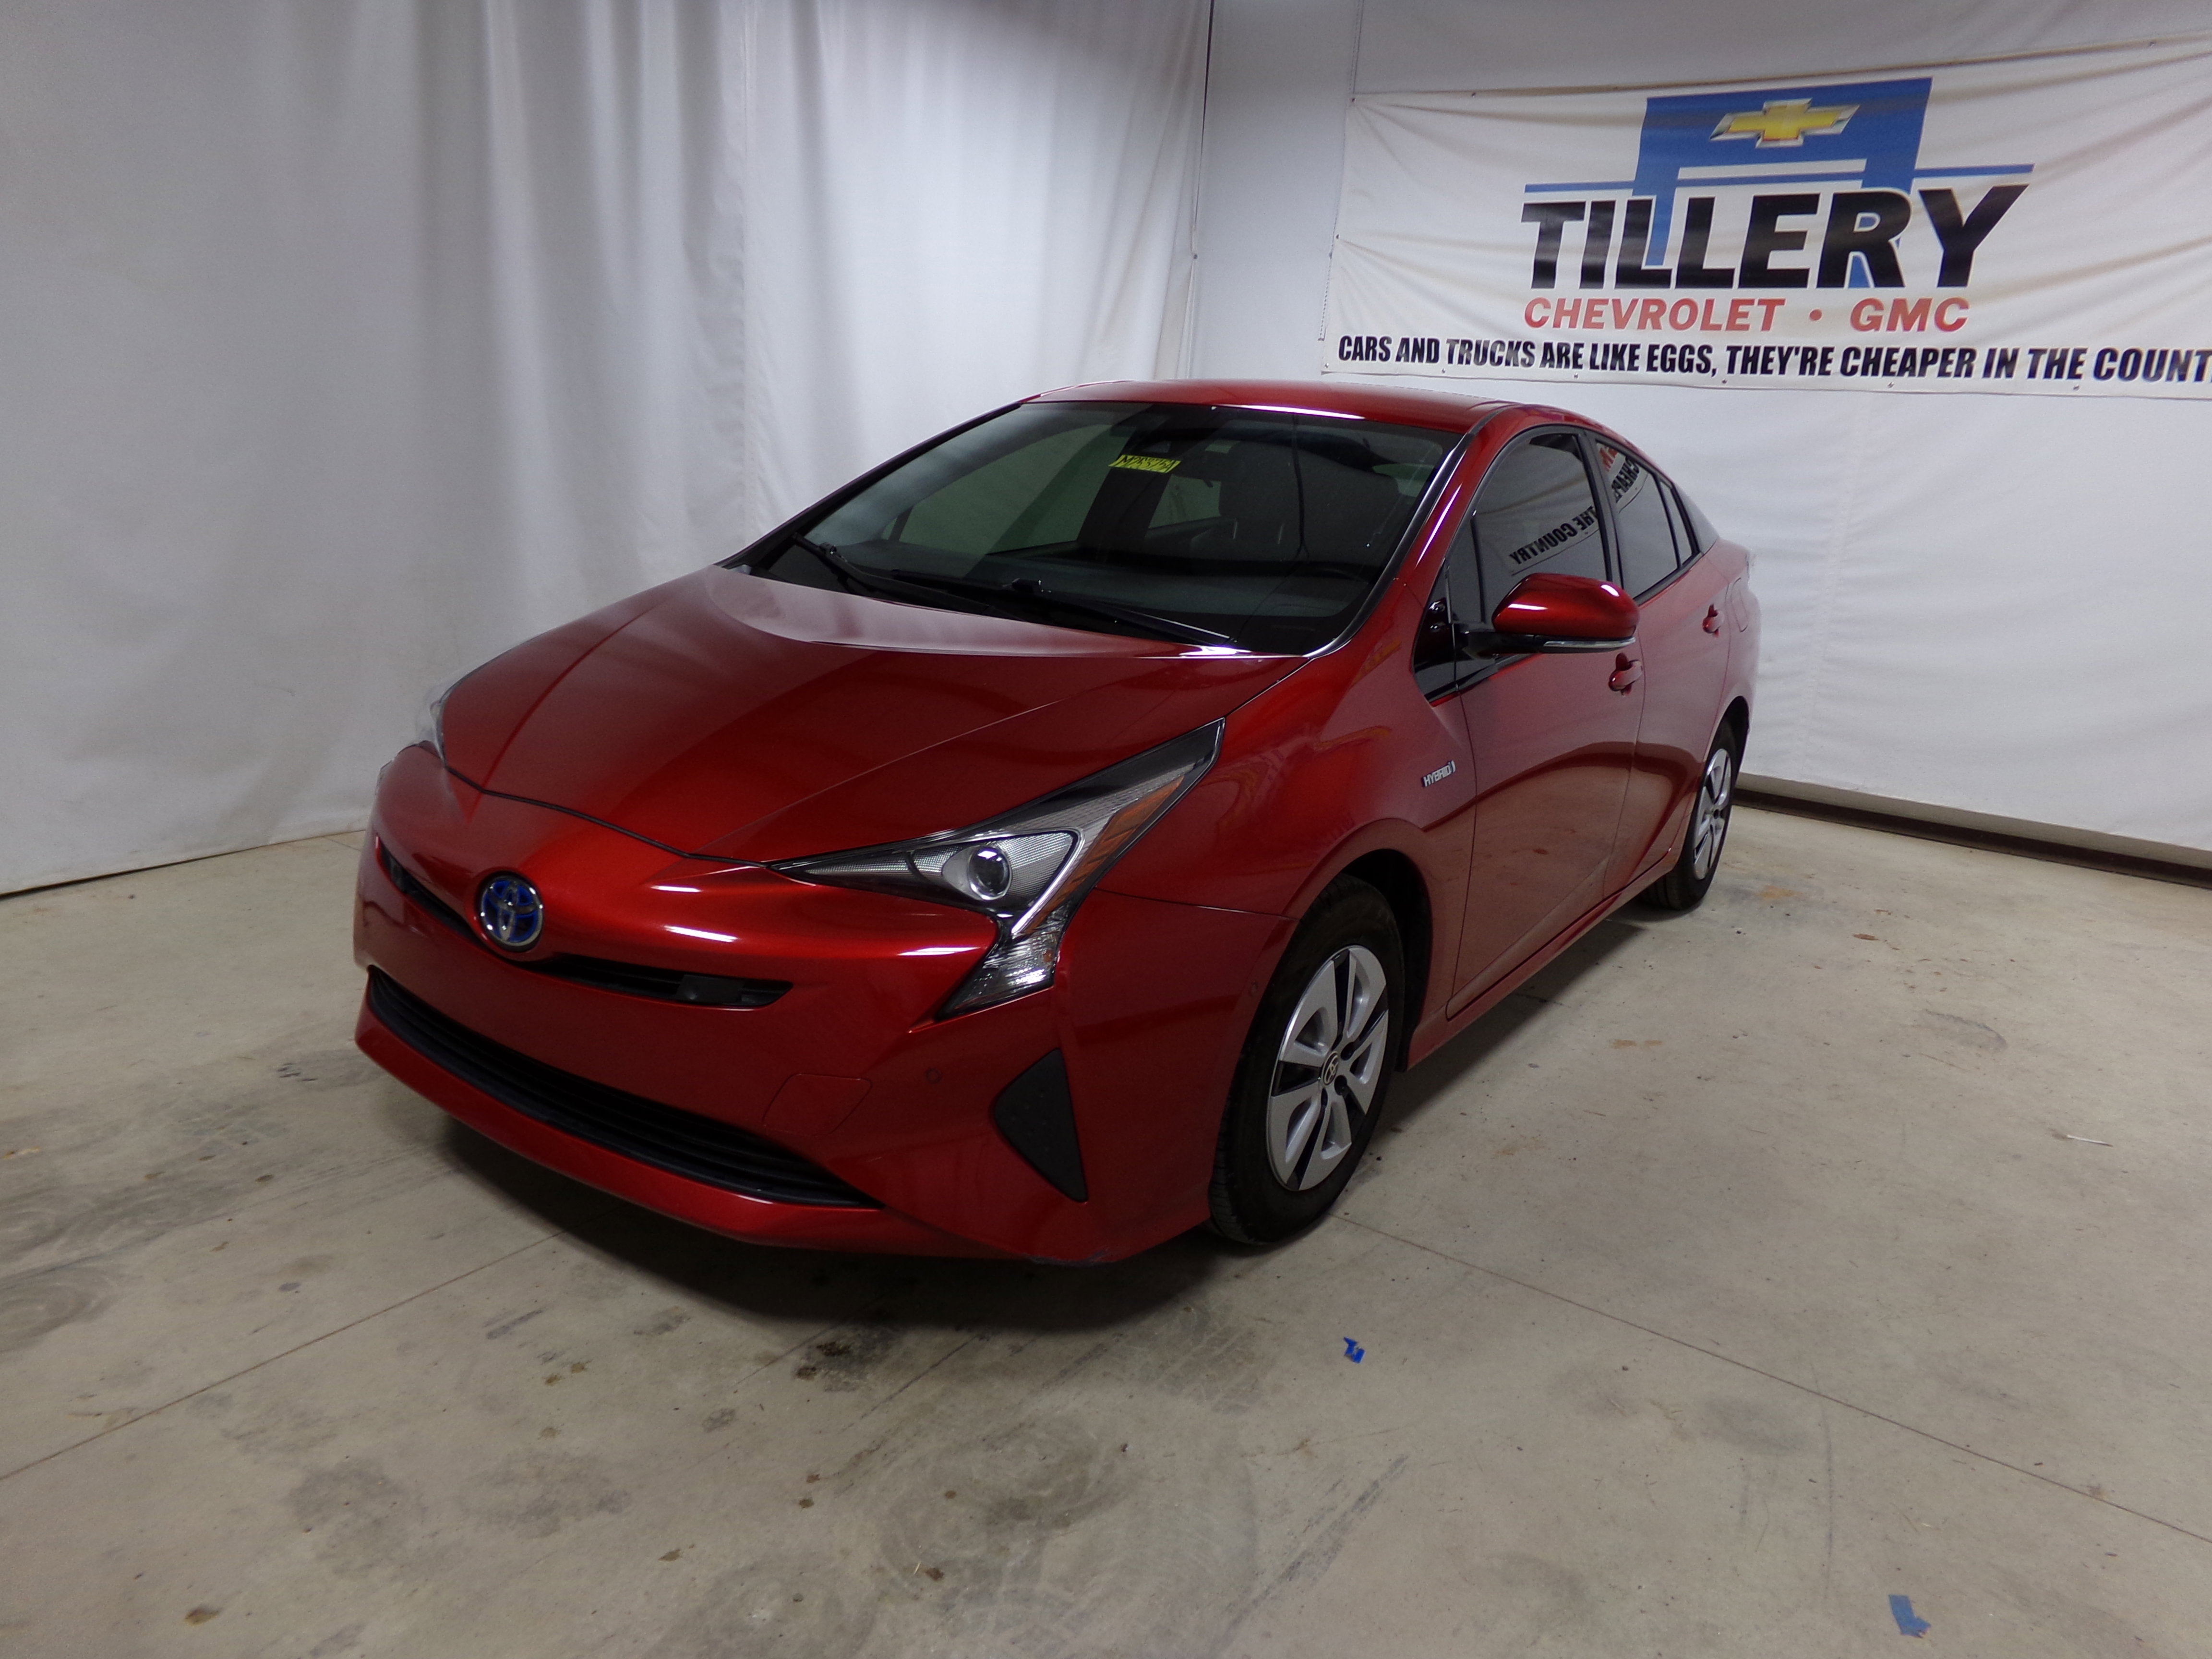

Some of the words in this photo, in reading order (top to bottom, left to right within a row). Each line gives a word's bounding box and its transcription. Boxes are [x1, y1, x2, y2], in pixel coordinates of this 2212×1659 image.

[1522, 184, 2030, 289] TILLERY
[1524, 297, 1785, 332] CHEVROLET
[1850, 297, 1970, 332] GMC
[1339, 336, 1392, 361] CARS
[1395, 337, 1440, 363] AND
[1445, 339, 1536, 367] TRUCKS
[1539, 342, 1585, 369] ARE
[1589, 343, 1641, 372] LIKE
[1647, 344, 1717, 377] EGGS,
[1726, 346, 1835, 376] THEY'RE
[1840, 347, 1976, 378] CHEAPER
[1983, 347, 2020, 378] IN
[2027, 348, 2088, 379] THE
[2093, 348, 2212, 383] COUNT
[1423, 764, 1453, 787] HYBRID
